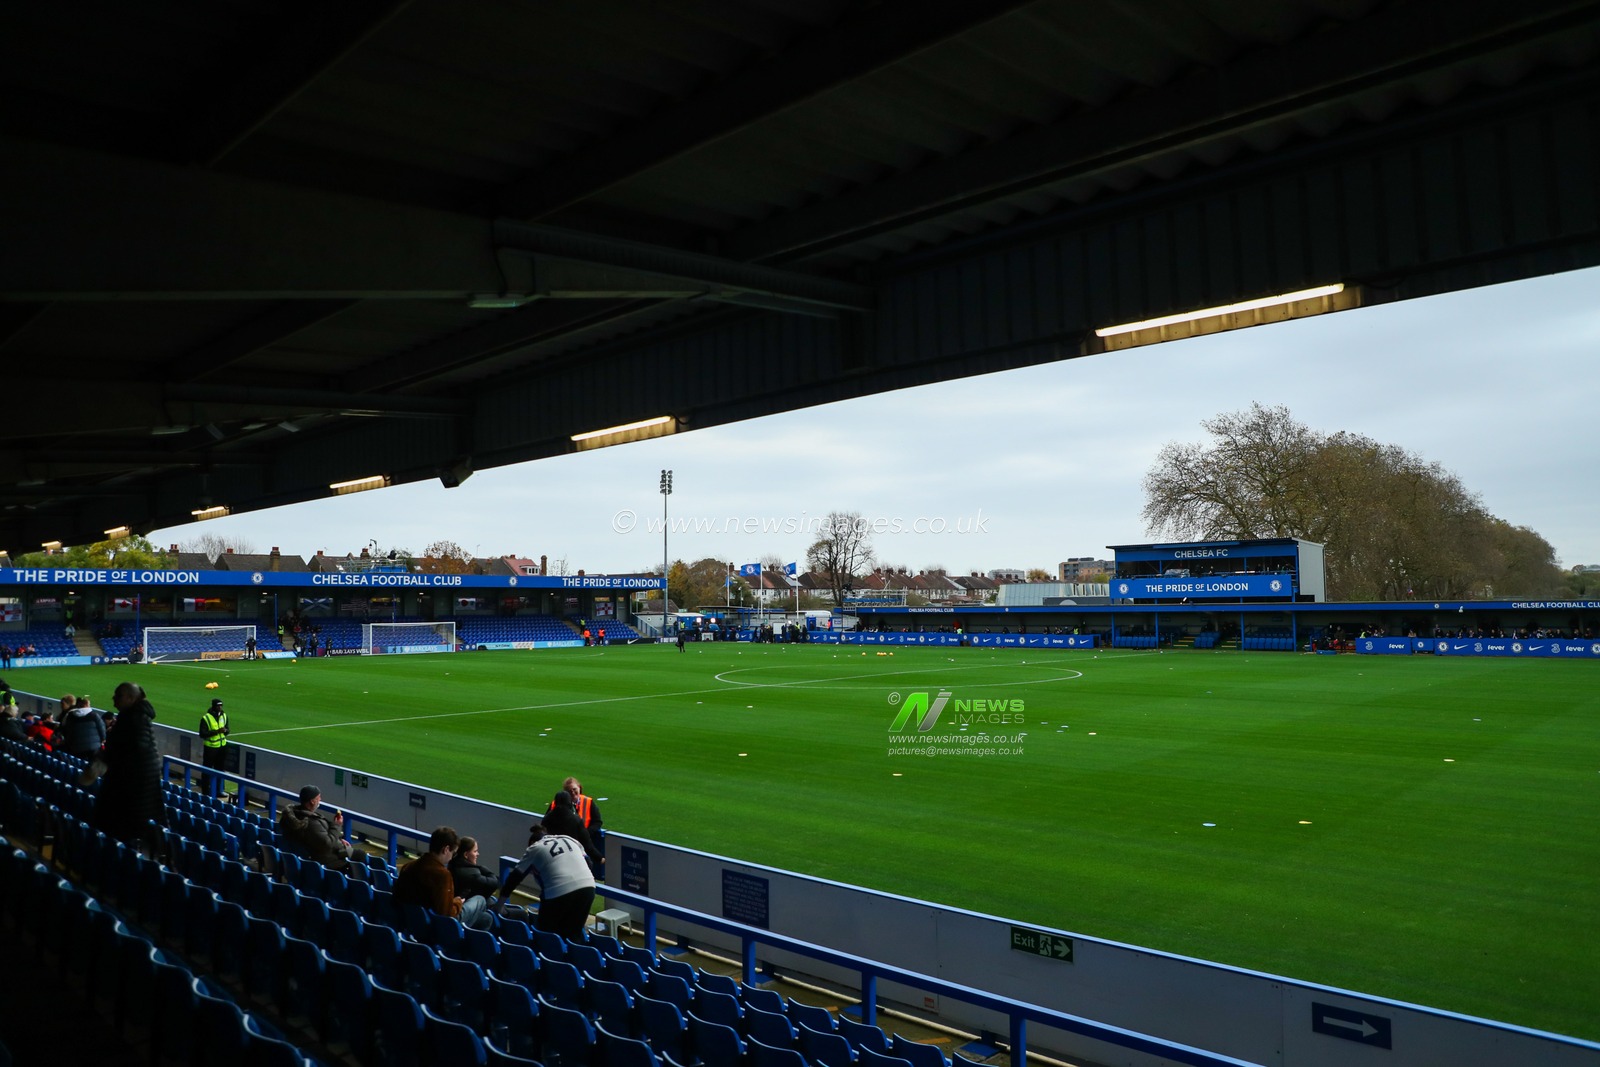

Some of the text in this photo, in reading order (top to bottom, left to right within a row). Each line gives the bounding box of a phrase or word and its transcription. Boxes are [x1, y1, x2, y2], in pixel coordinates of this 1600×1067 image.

[1174, 549, 1228, 559] CHELSEA FC
[13, 570, 199, 583] THE PRIDE OF LONDON
[312, 574, 462, 586] CHELSEA FOOTBALL CLUB
[562, 577, 580, 587] THE
[583, 578, 610, 587] PRIDE
[623, 578, 660, 588] LONDON
[1146, 584, 1163, 592] THE
[1165, 583, 1193, 592] PRIDE
[1207, 582, 1249, 591] LONDON
[26, 657, 67, 665] BARCLAYS
[543, 838, 573, 857] 21
[1014, 932, 1035, 948] Exit
